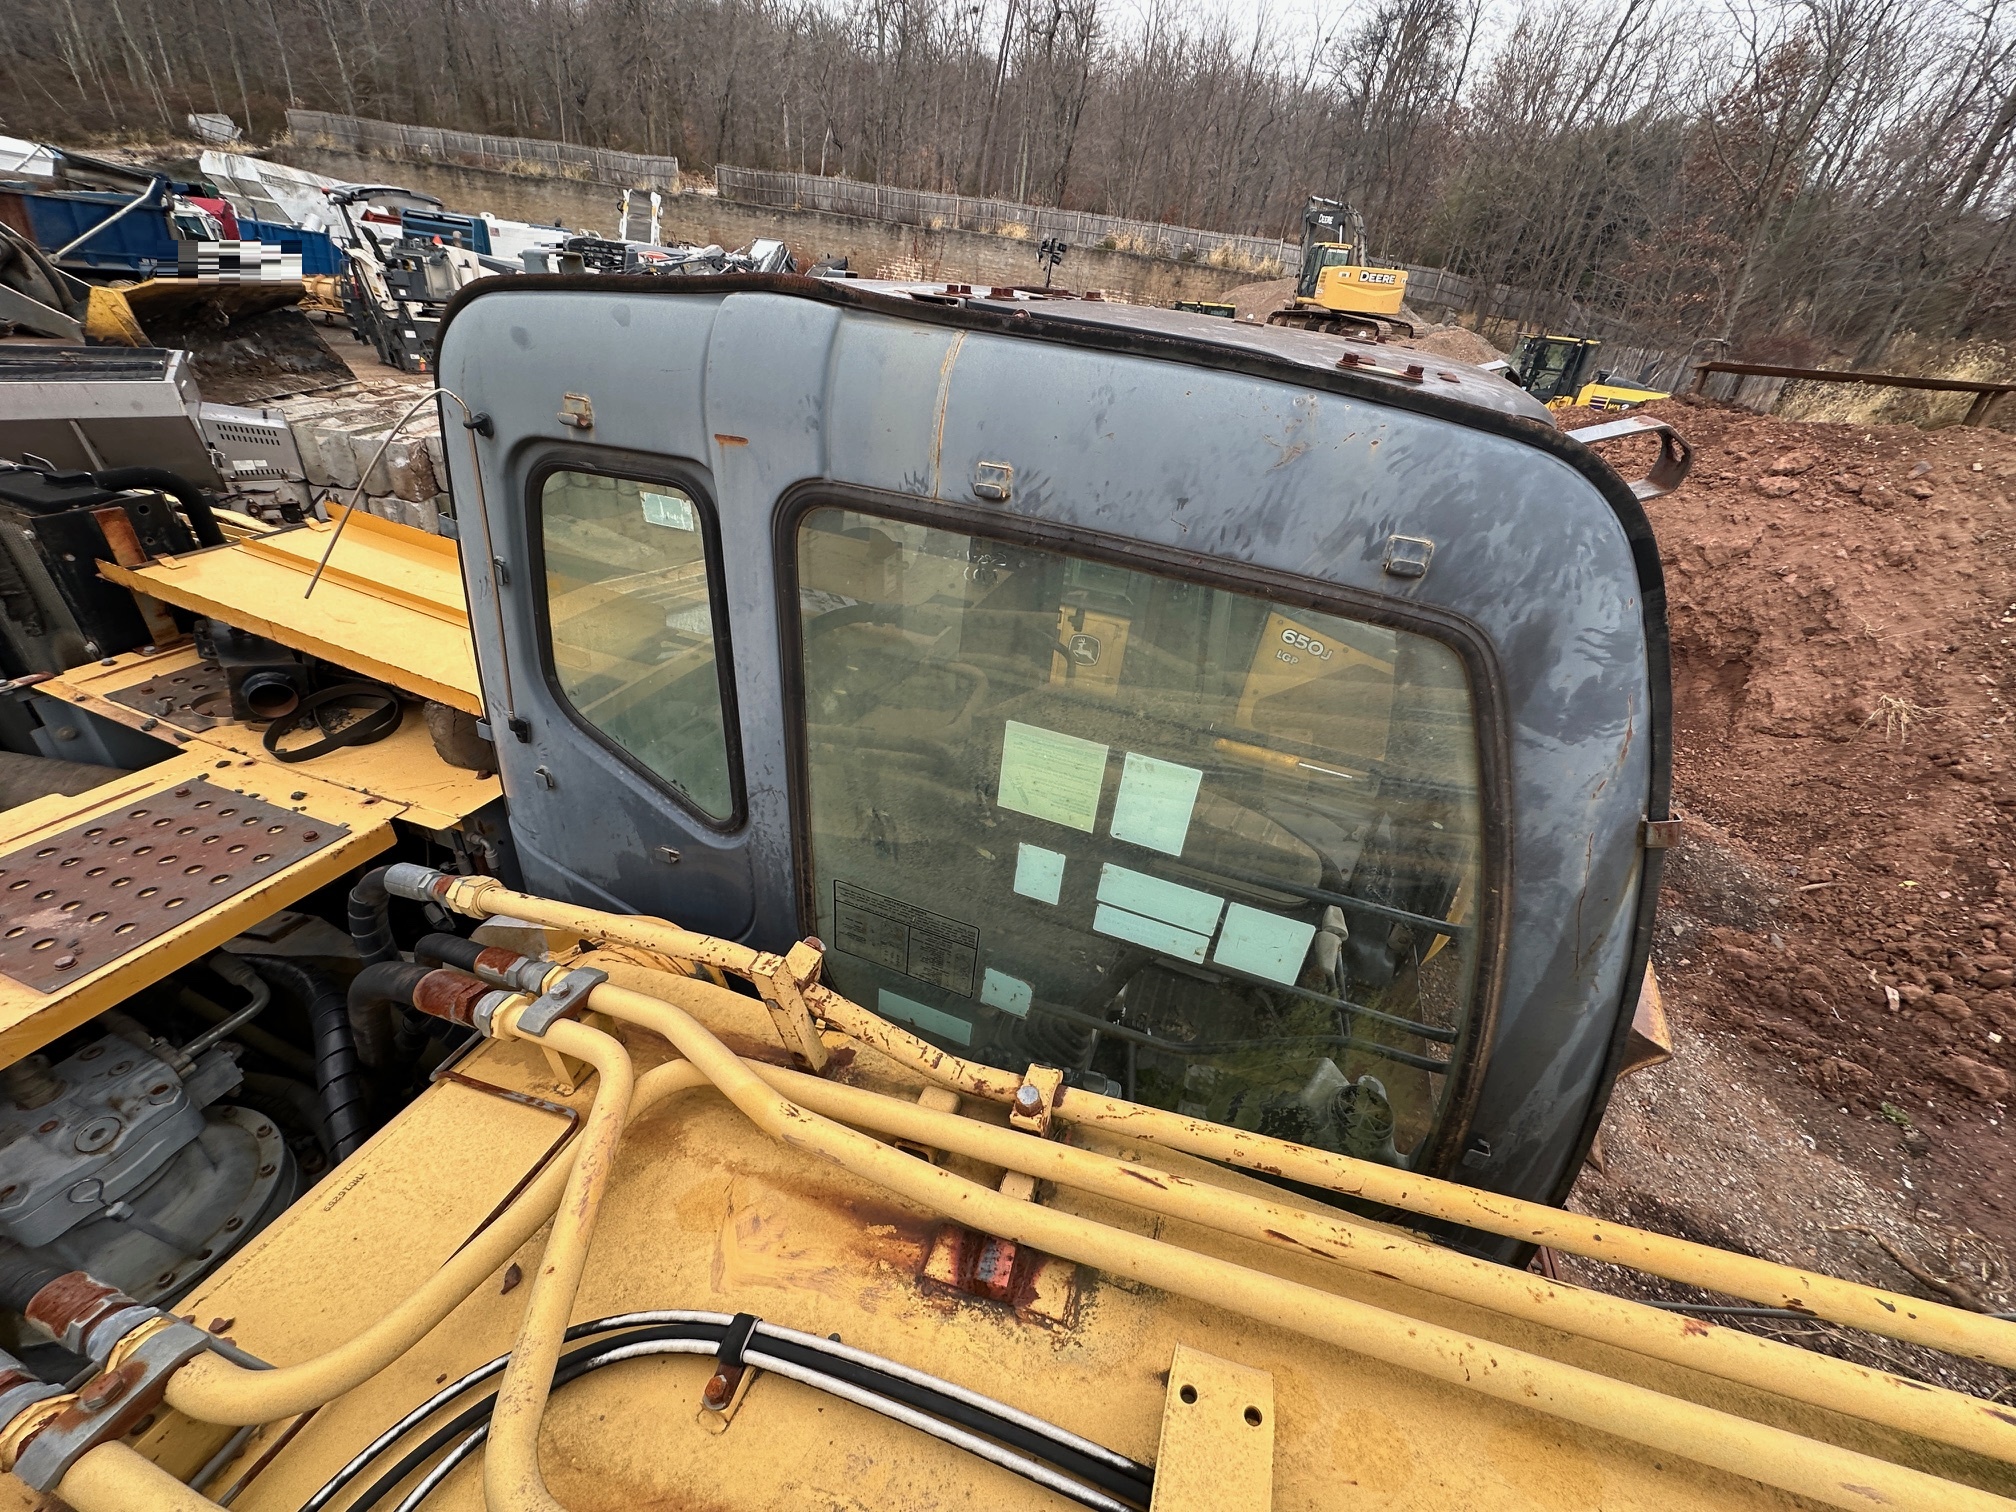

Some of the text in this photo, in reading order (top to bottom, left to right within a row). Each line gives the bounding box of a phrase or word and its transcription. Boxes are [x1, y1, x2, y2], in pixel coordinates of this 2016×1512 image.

[1318, 213, 1334, 225] DEERE
[1359, 270, 1396, 284] DEERE
[1281, 628, 1333, 660] 650J
[1275, 649, 1300, 665] LGP
